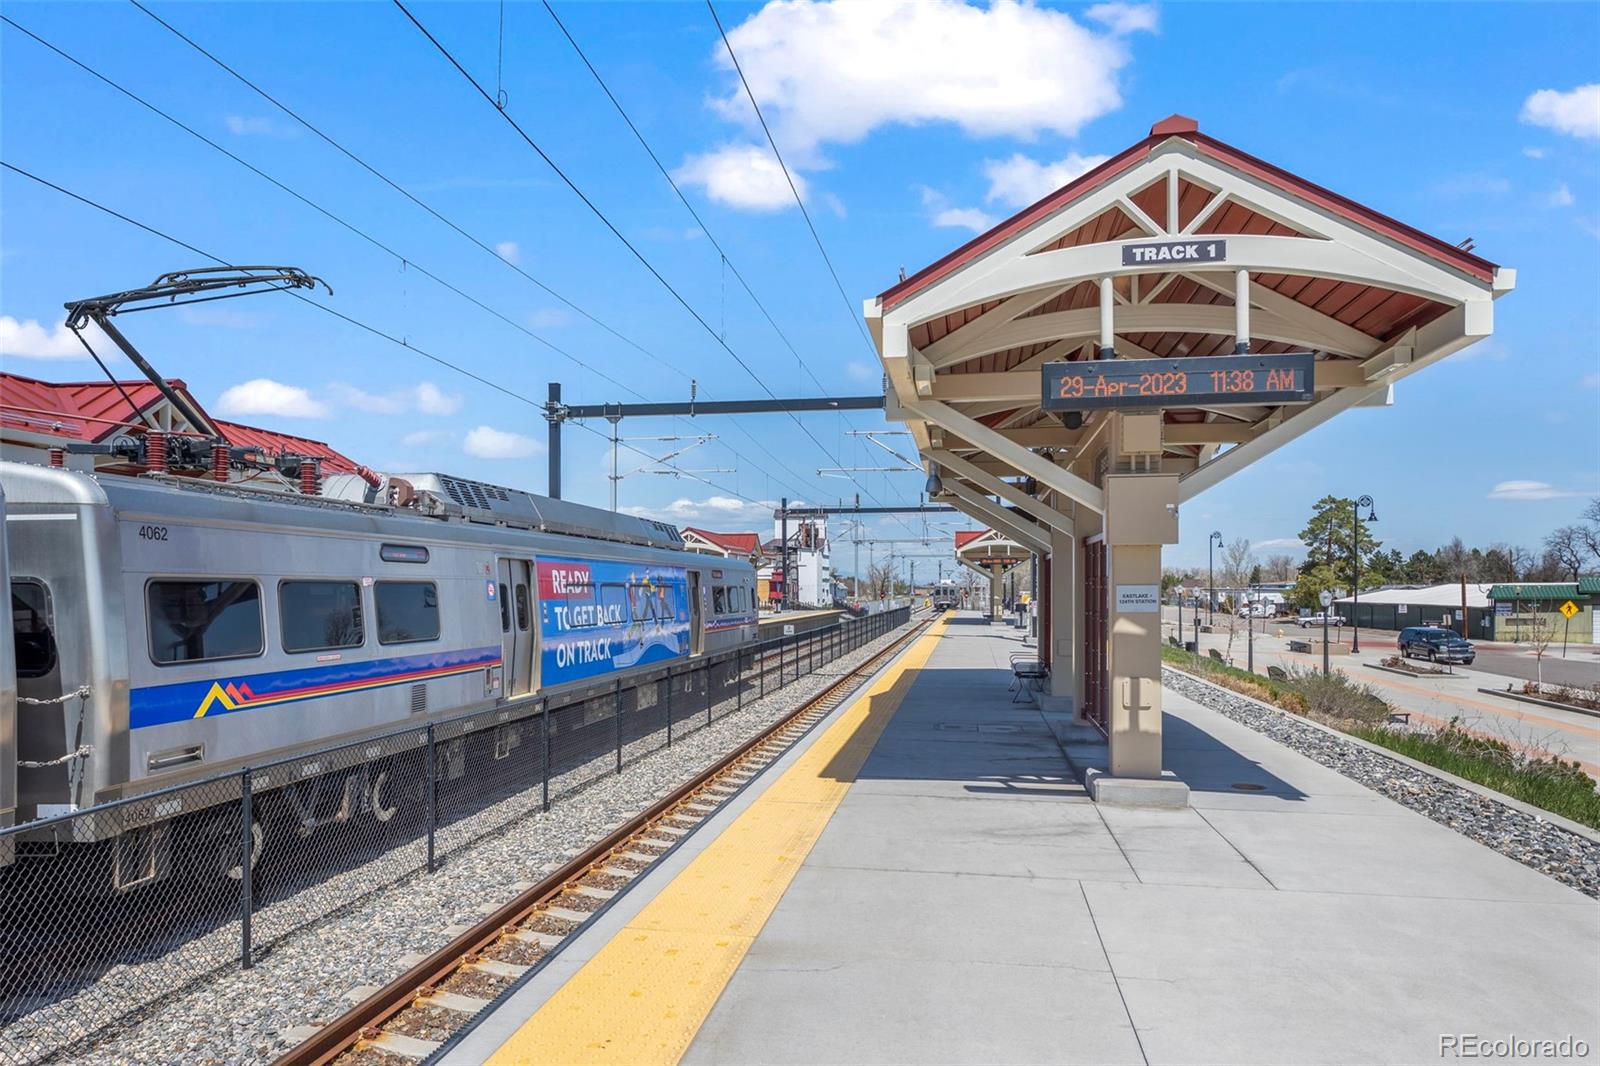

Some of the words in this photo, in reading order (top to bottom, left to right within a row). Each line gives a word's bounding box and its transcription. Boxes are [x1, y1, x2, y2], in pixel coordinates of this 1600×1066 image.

[1132, 244, 1200, 261] TRACK
[1207, 243, 1216, 258] 1
[1060, 371, 1187, 399] 29-Apr-2023
[1210, 369, 1254, 393] 11:38
[1266, 367, 1297, 392] AM
[139, 525, 168, 541] 4062
[552, 569, 589, 594] READY
[554, 606, 572, 631] TO
[573, 606, 595, 628] GET
[597, 604, 622, 626] BACK
[556, 643, 576, 668] ON
[577, 638, 611, 664] TRACK
